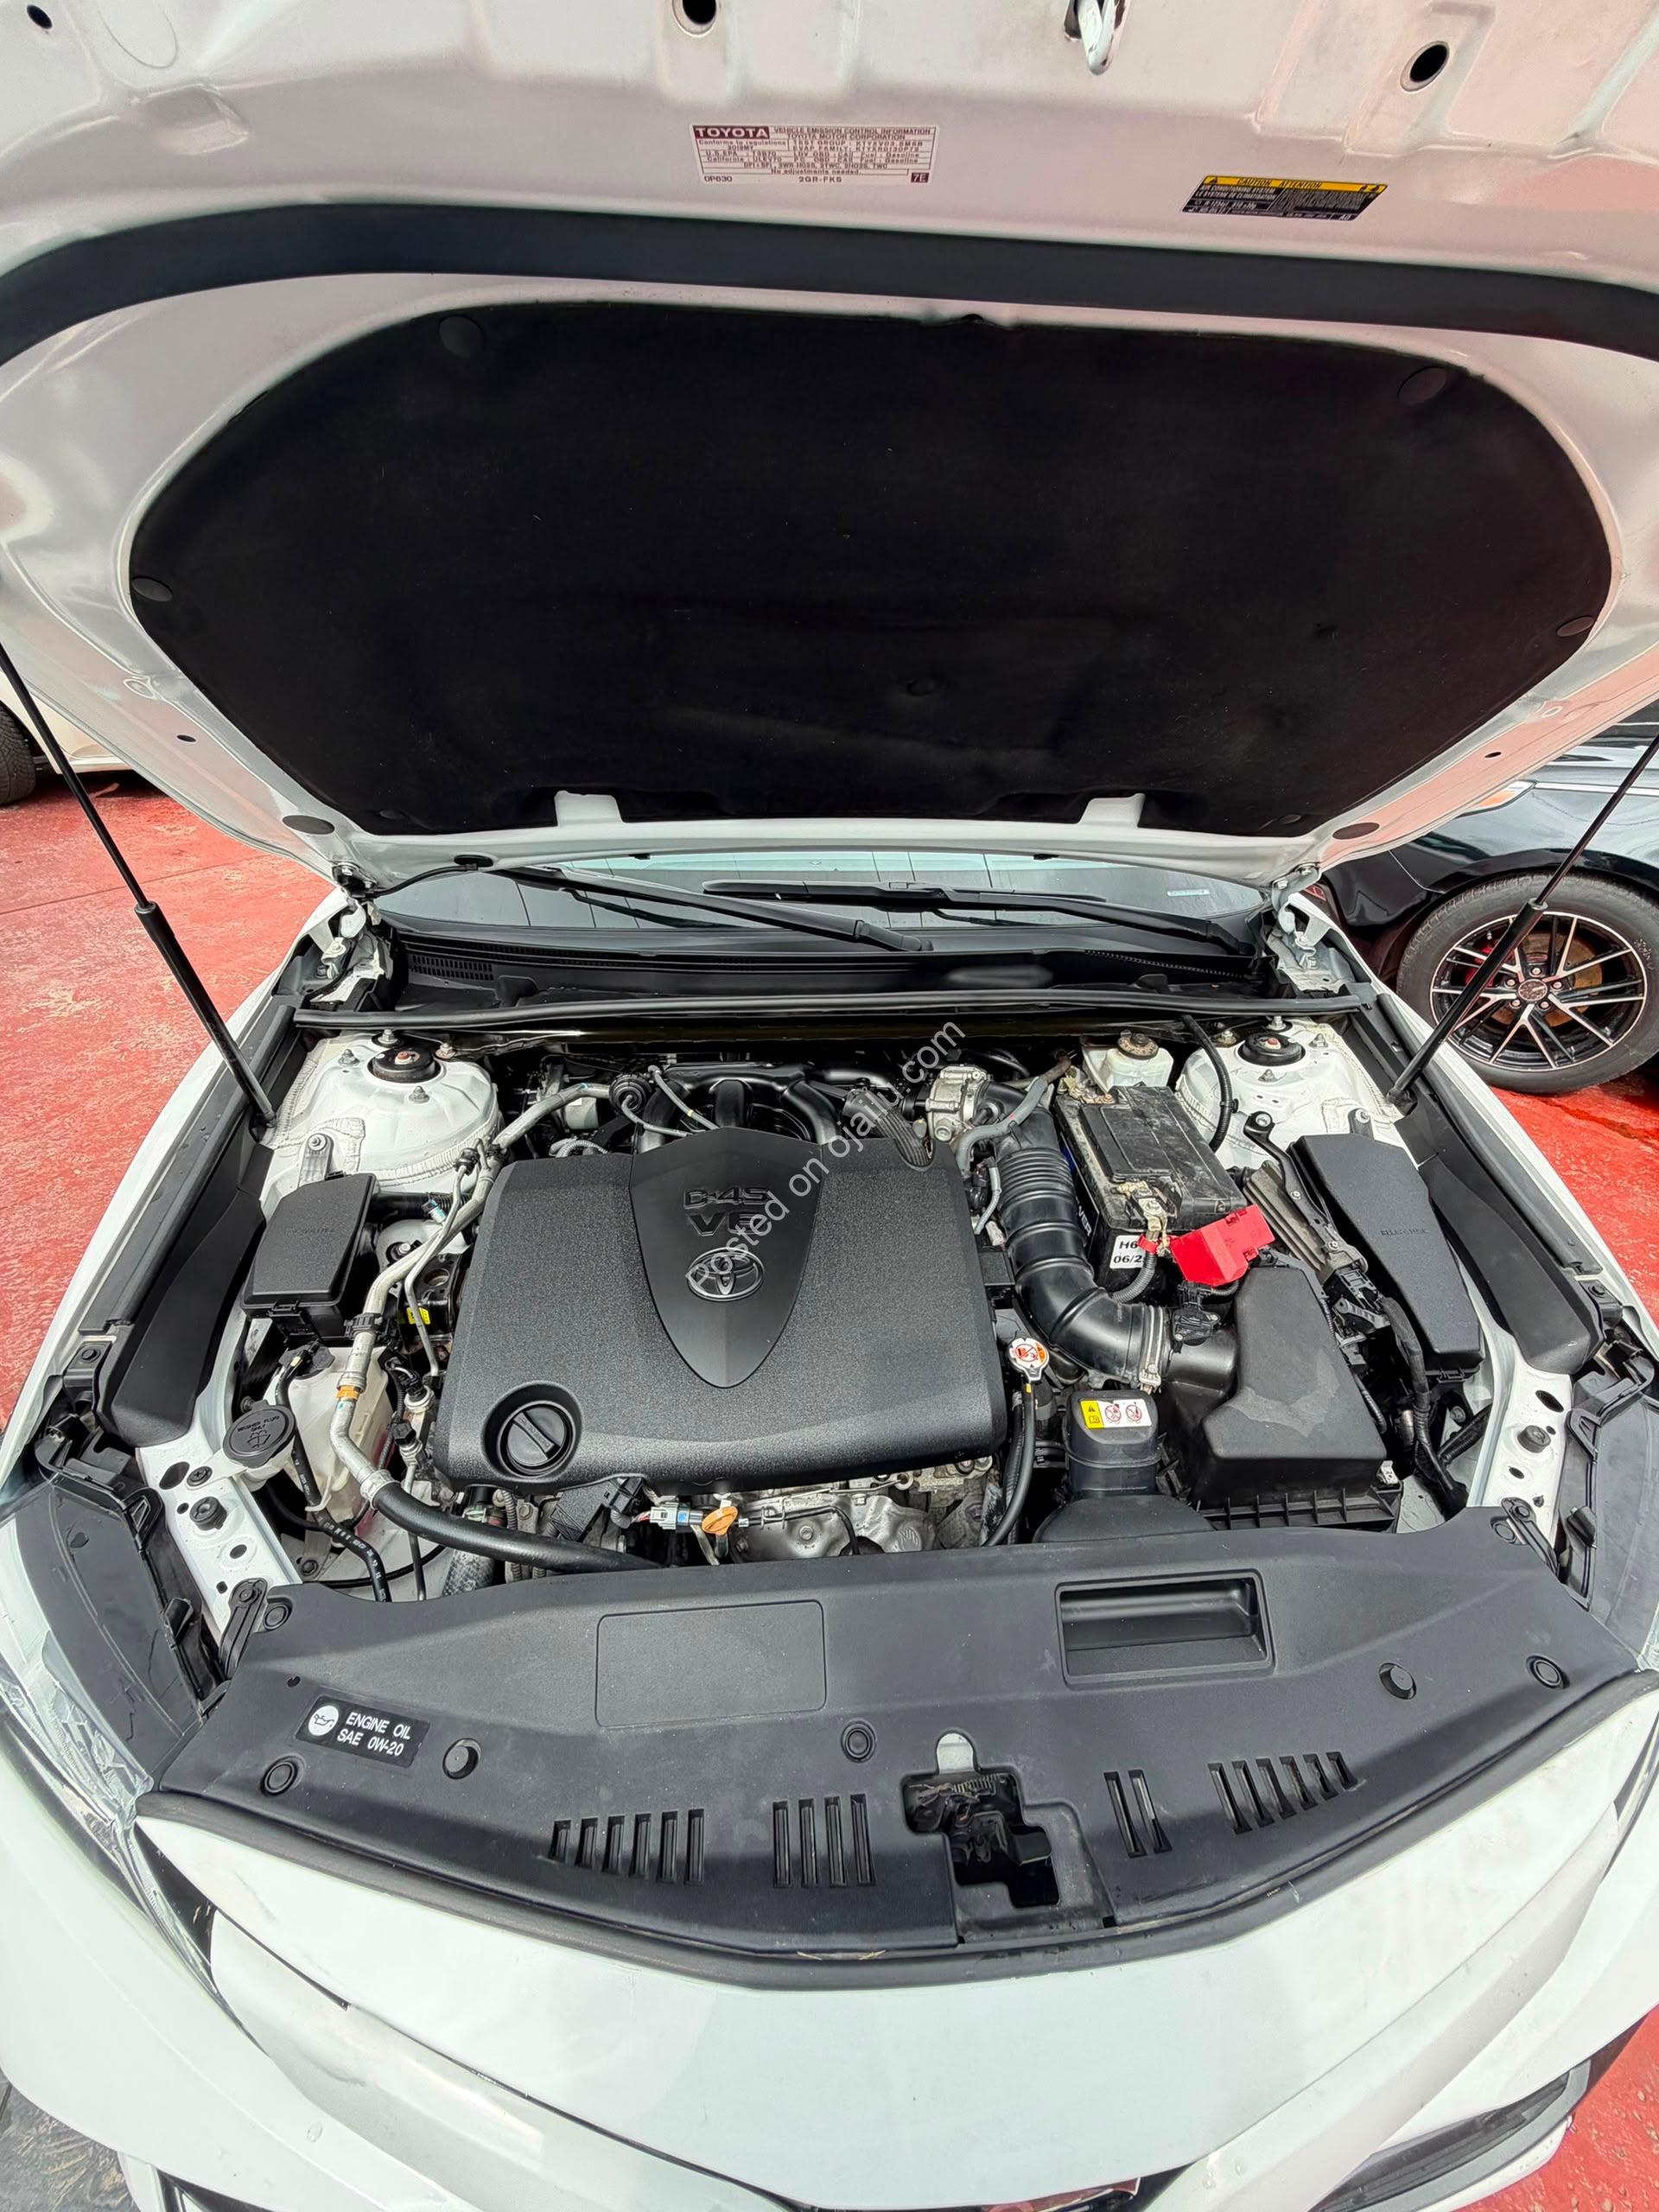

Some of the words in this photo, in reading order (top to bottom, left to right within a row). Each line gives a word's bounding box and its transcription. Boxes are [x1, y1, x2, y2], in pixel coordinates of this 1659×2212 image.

[695, 127, 769, 138] TOYOTA
[912, 173, 928, 182] 7E
[1237, 177, 1271, 187] CAUTION
[1278, 179, 1323, 189] ATTENTION
[1113, 1255, 1143, 1264] 06/2
[345, 1712, 390, 1734] ENGINE
[392, 1724, 411, 1740] OIL
[337, 1728, 364, 1746] SAE
[367, 1736, 404, 1757] 0W-20
